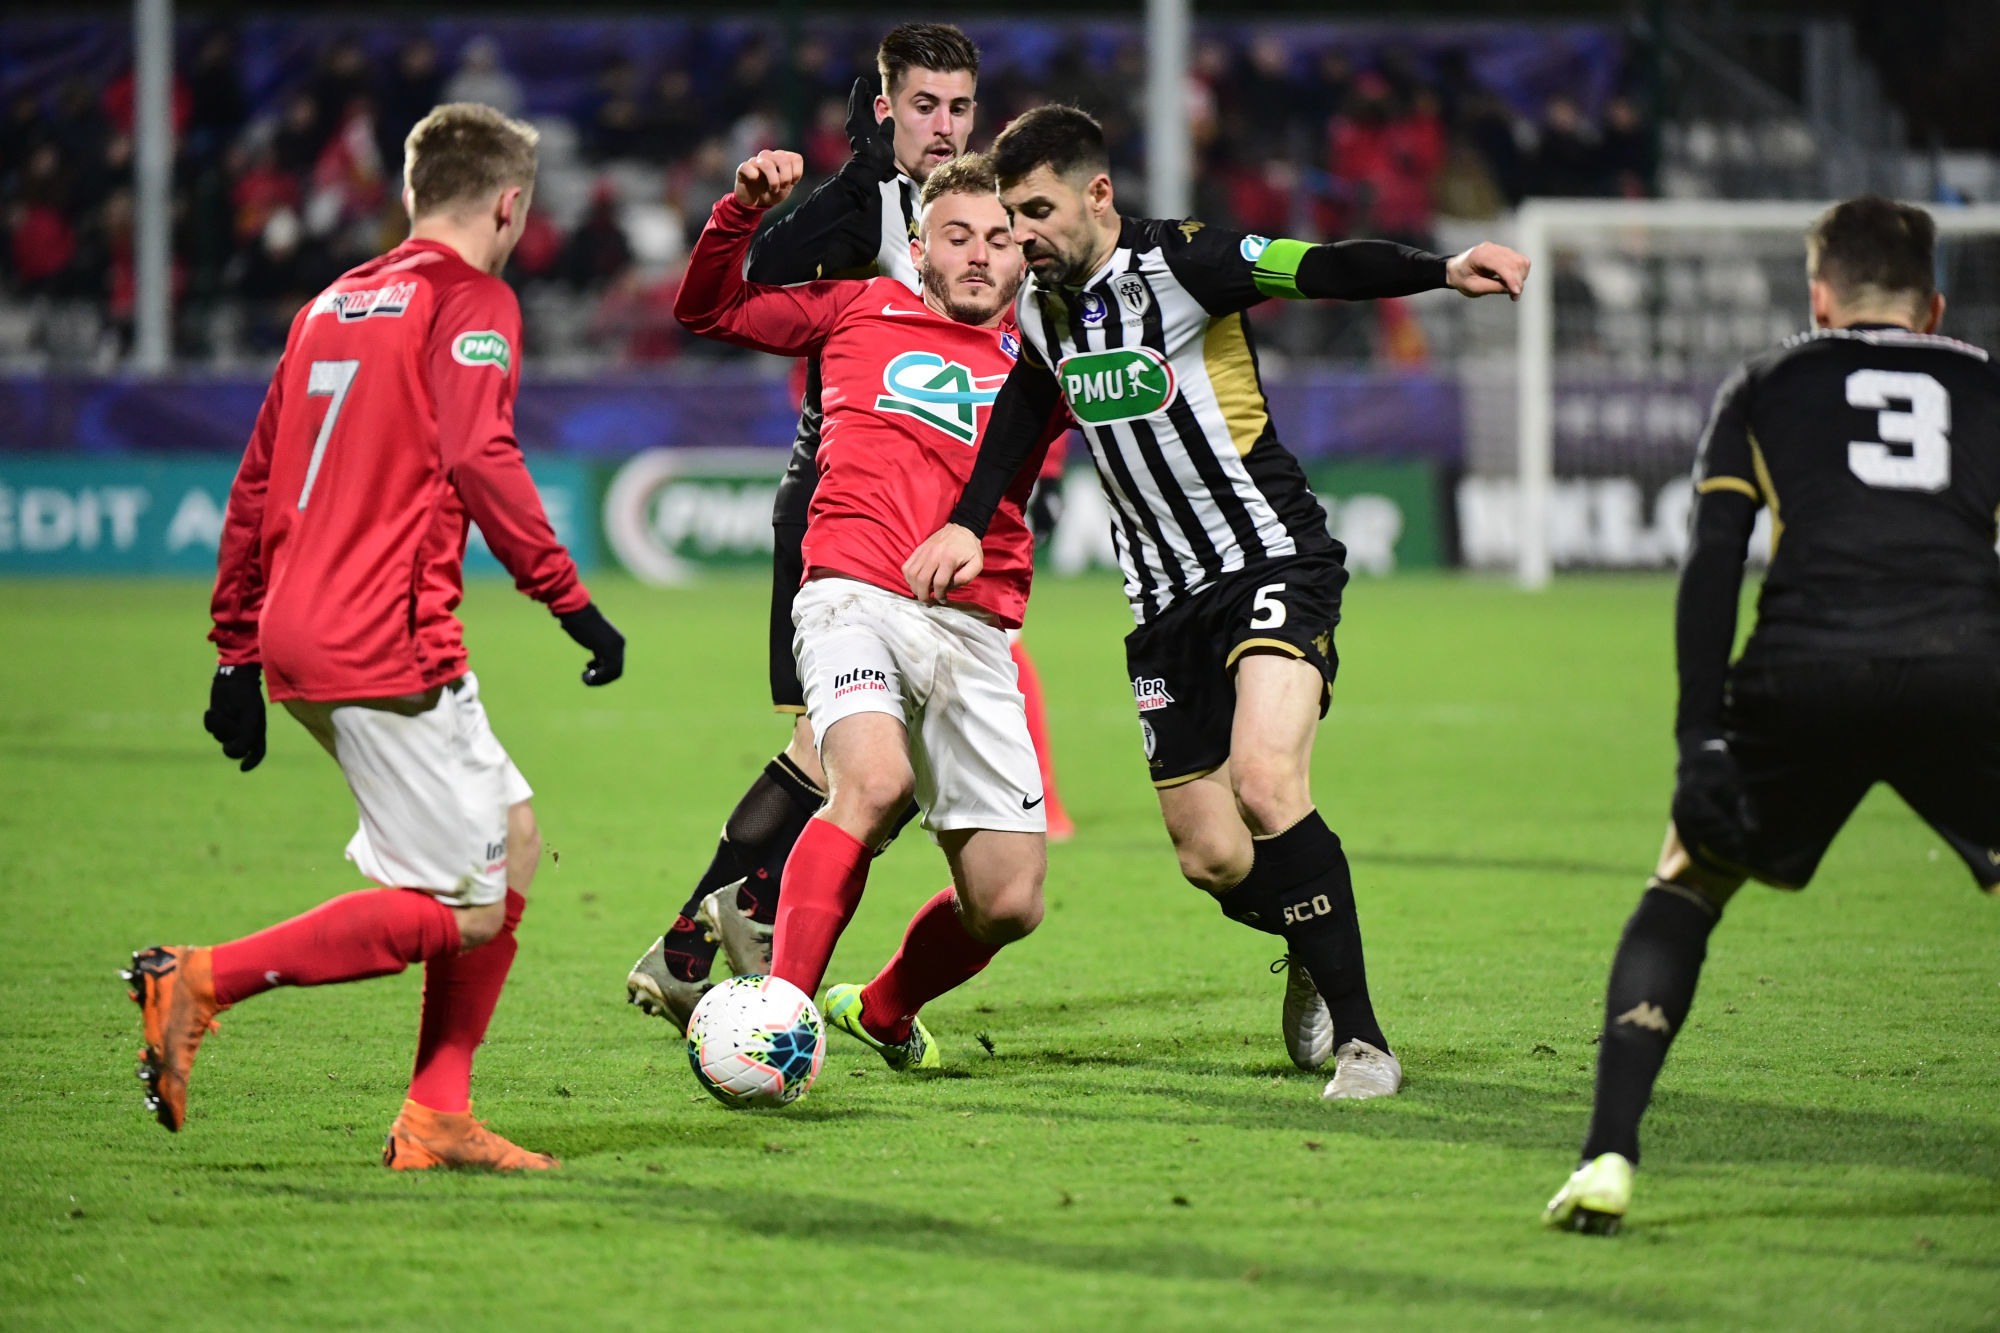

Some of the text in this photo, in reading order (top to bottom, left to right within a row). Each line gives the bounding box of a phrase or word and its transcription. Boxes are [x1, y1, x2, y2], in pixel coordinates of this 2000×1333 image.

[463, 338, 504, 357] PMU
[1065, 369, 1124, 404] PMU
[298, 359, 360, 512] 7
[1845, 368, 1951, 494] 3
[1250, 583, 1287, 630] 5
[1283, 894, 1332, 926] SCO
